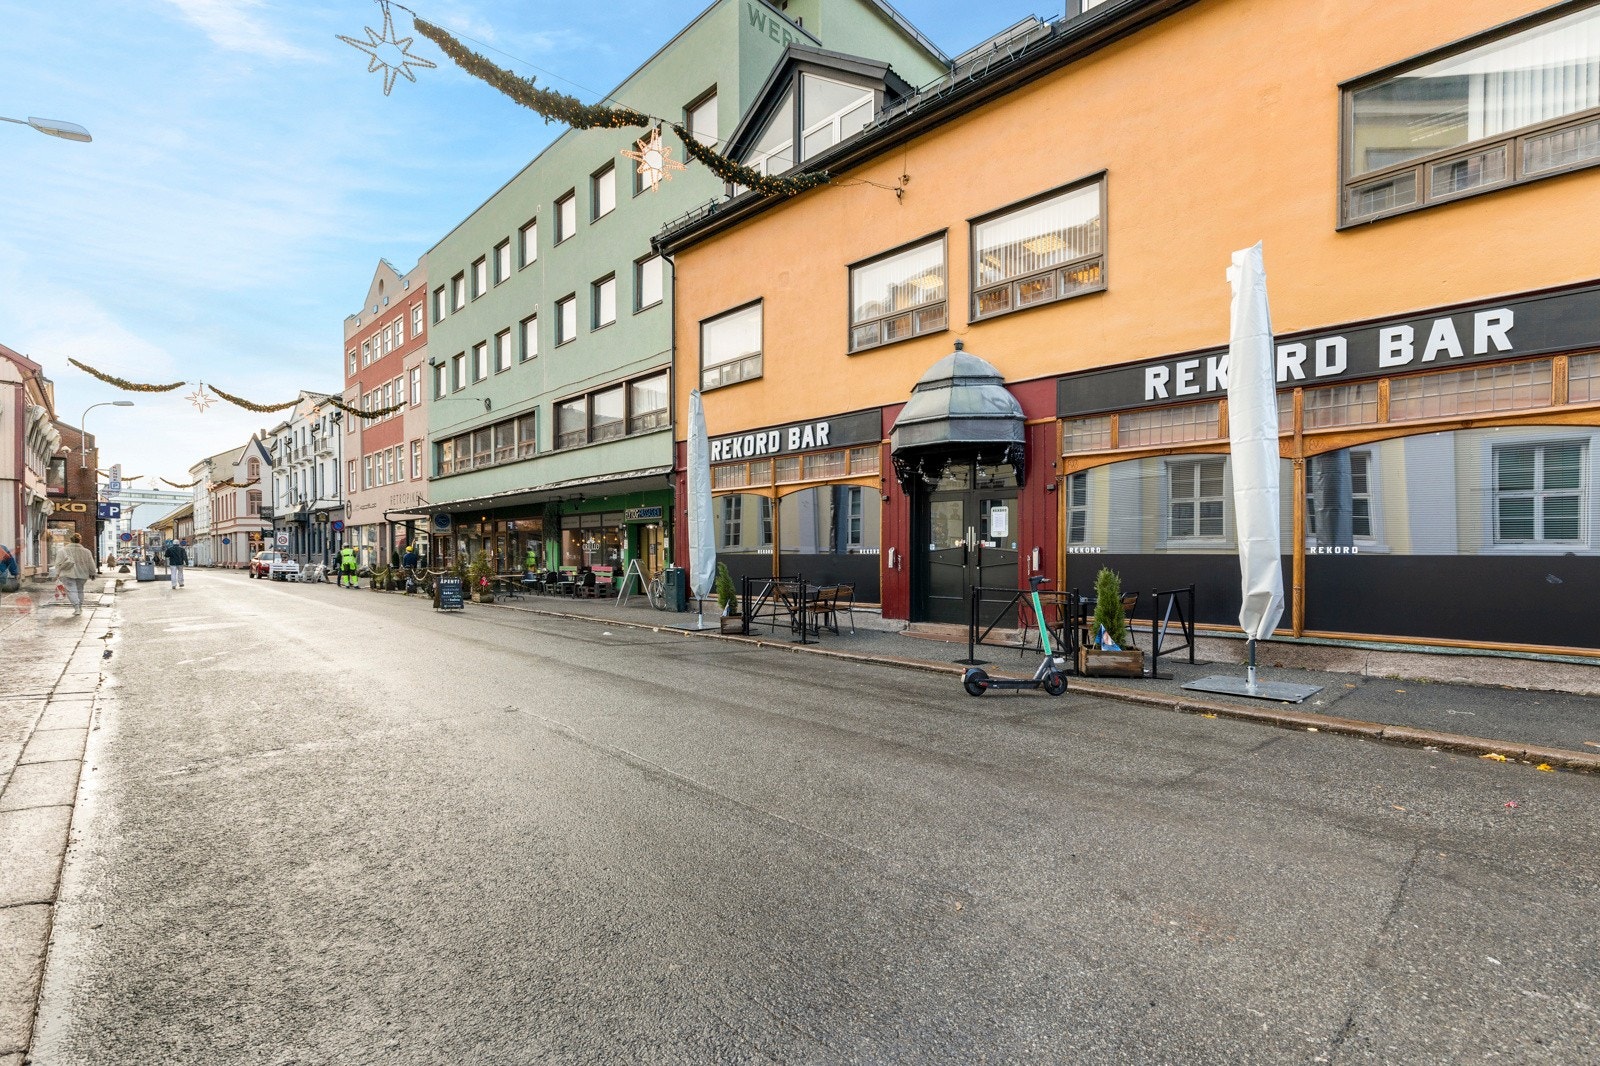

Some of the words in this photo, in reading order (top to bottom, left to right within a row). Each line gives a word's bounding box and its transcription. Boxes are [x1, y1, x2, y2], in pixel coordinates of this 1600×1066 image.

[1144, 335, 1348, 401] REKRD
[1379, 307, 1515, 369] BAR
[710, 429, 781, 461] REKORD
[788, 421, 830, 451] BAR
[53, 502, 87, 513] KO
[109, 506, 119, 516] P
[1069, 546, 1101, 554] REKORD
[1310, 546, 1359, 554] REKORD
